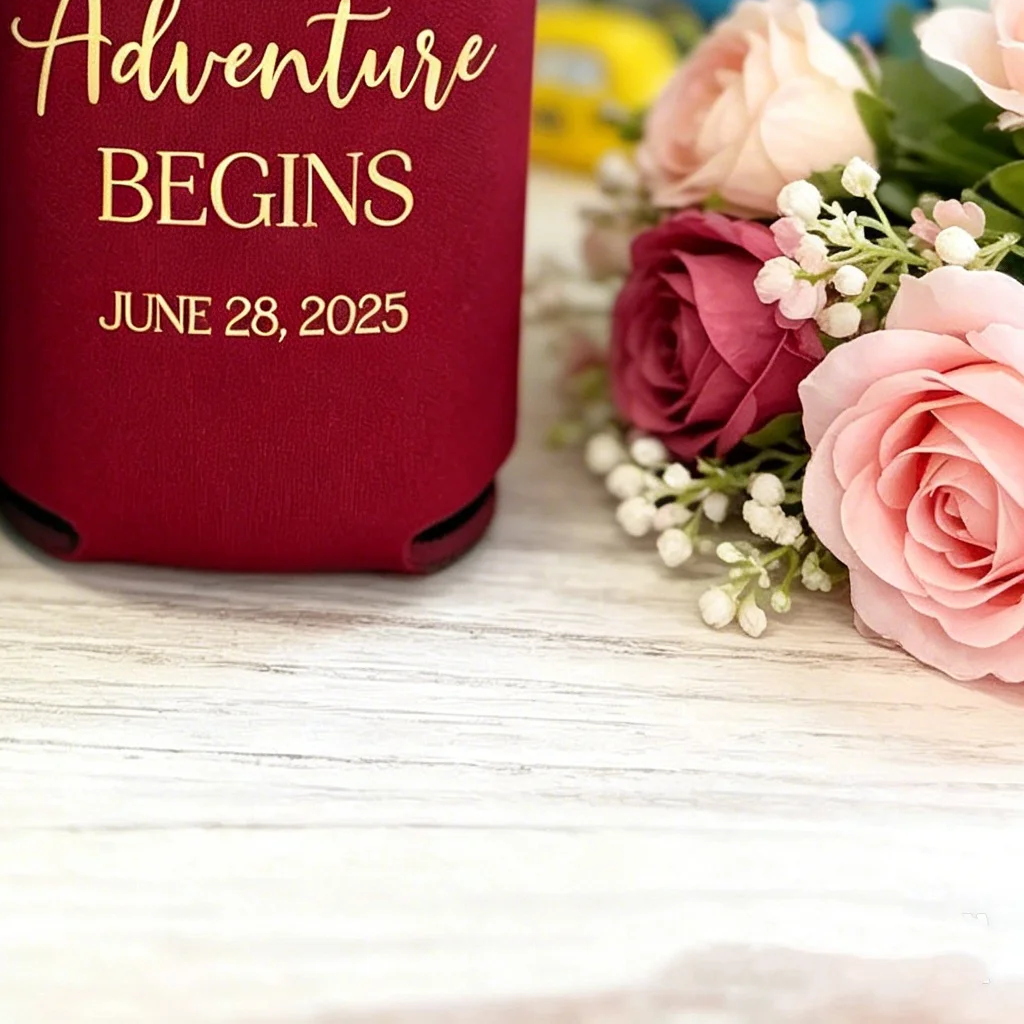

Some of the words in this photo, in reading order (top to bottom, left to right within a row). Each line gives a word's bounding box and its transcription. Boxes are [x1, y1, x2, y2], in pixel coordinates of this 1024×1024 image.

[97, 147, 414, 229] BEGINS
[98, 290, 212, 335] JUNE
[224, 295, 287, 343] 28,
[299, 291, 409, 337] 2025
